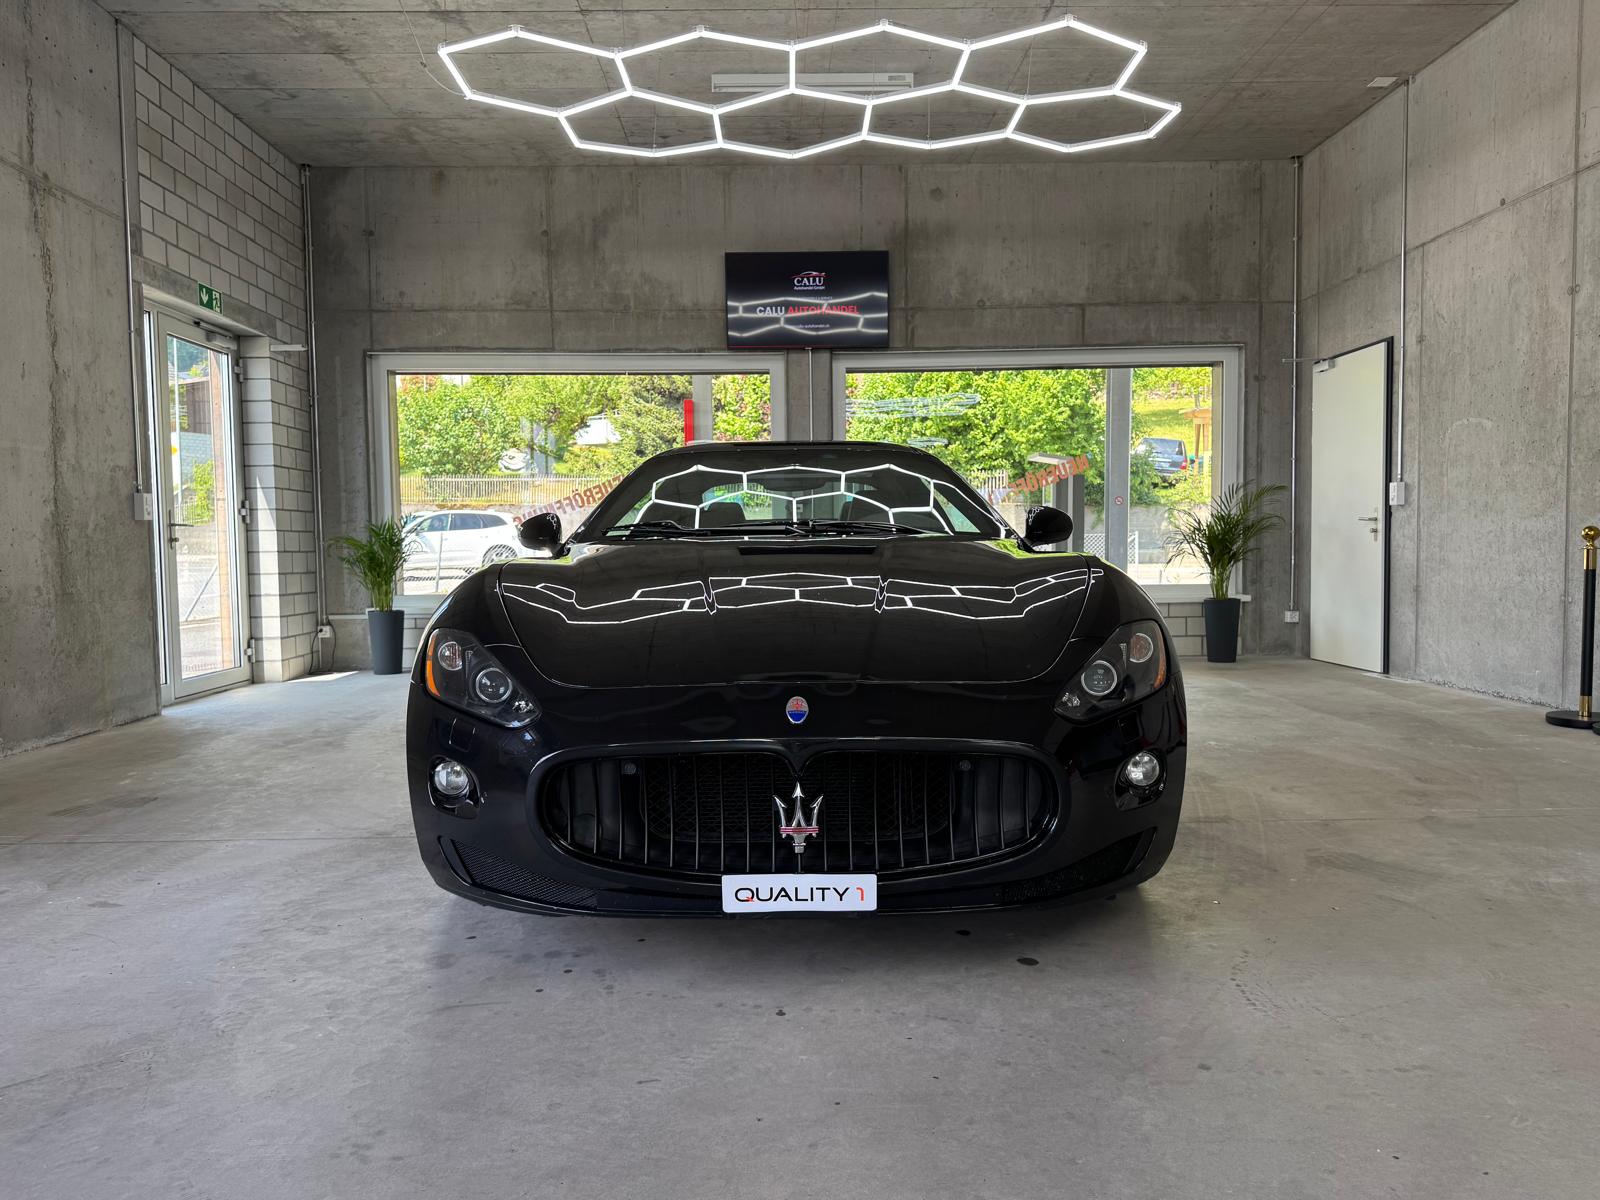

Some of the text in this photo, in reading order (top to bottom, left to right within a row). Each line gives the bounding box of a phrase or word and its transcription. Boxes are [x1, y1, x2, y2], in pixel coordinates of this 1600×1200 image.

[794, 277, 824, 286] CALU
[756, 305, 859, 316] CALU AUTOHANDEL
[735, 887, 864, 902] QUALITY 1
